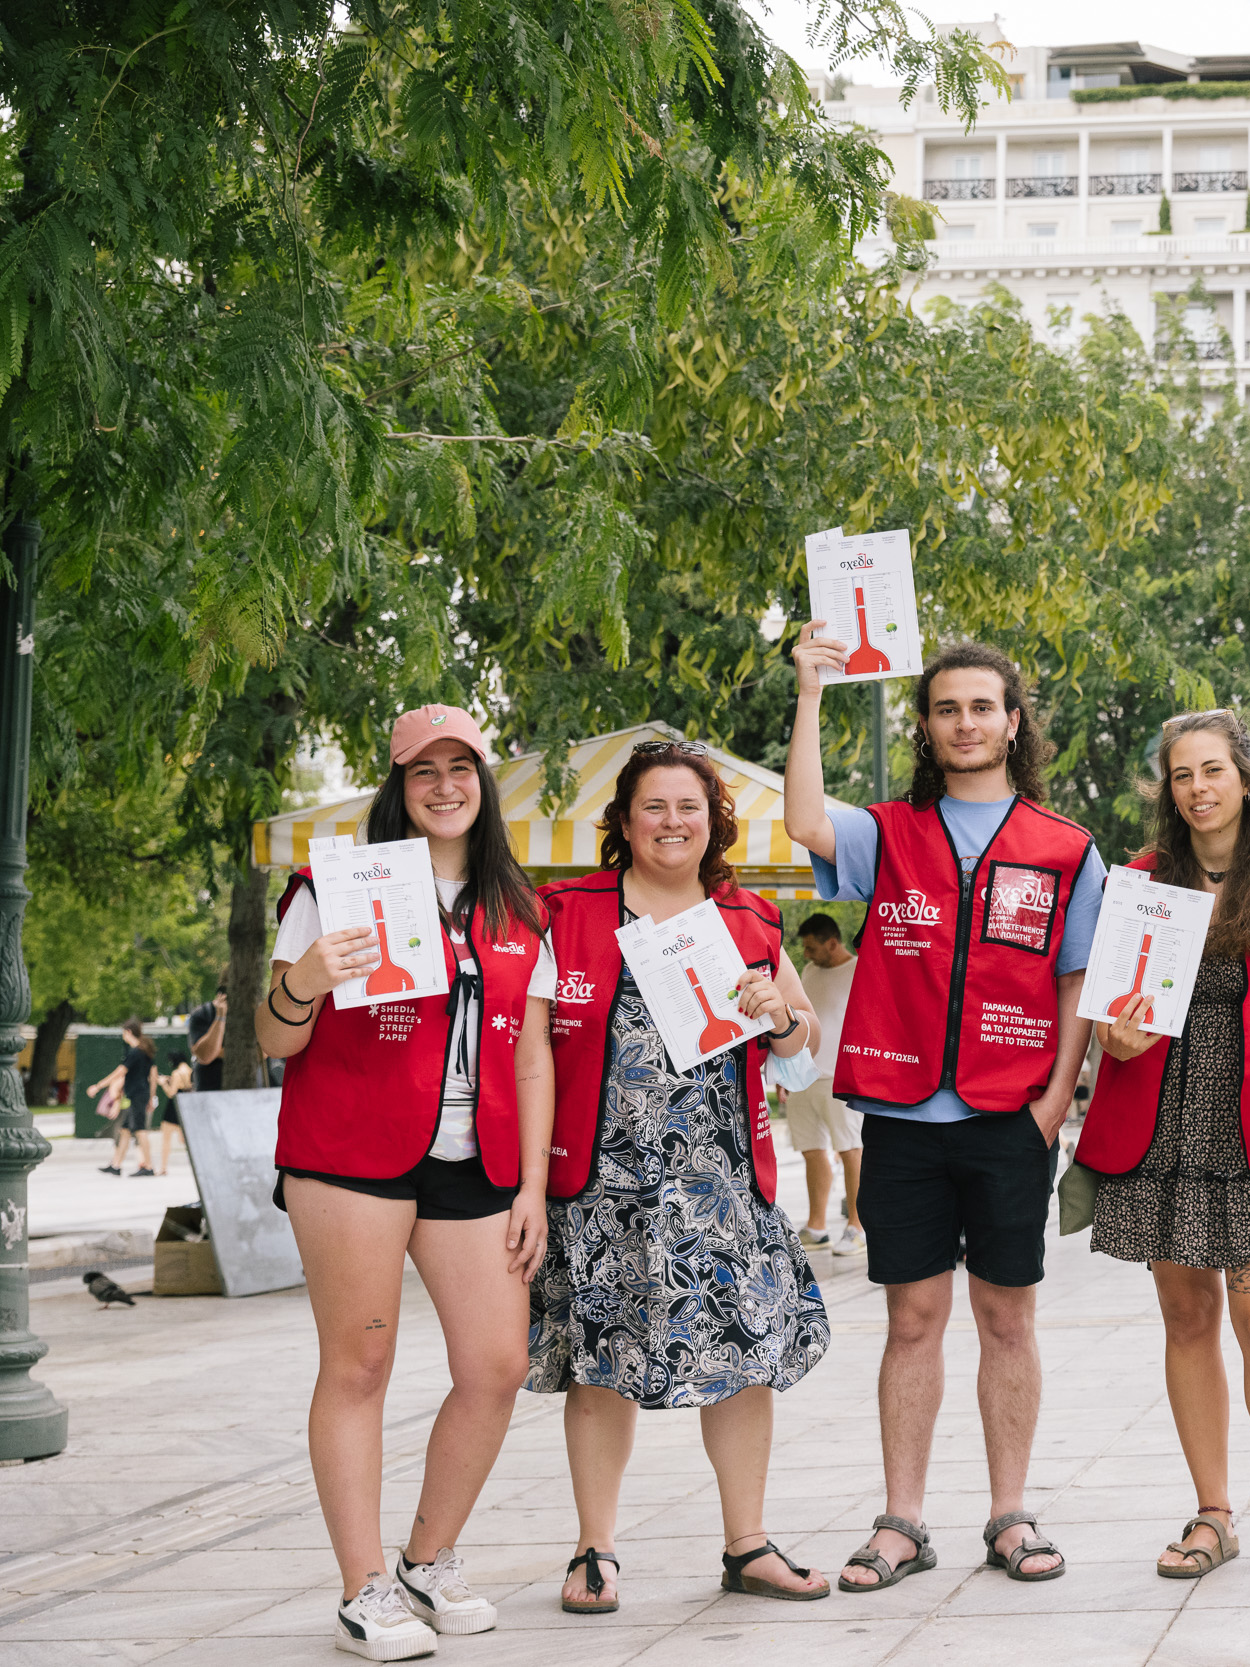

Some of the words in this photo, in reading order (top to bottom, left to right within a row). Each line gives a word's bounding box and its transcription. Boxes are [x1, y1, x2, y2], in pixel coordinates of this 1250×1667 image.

[380, 1005, 416, 1014] SHEDIA
[982, 1002, 1024, 1015] ΠΑΡΑΚΑΛΩ,
[380, 1014, 422, 1024] GREECE's
[981, 1013, 998, 1022] ΑΠΟ
[999, 1015, 1009, 1023] ΤΗ
[1010, 1016, 1036, 1026] ΣΤΙΓΜΗ
[1037, 1020, 1053, 1028] ΠΟΥ
[379, 1023, 413, 1032] STREET
[981, 1023, 992, 1032] ΘΑ
[993, 1025, 1003, 1033] ΤΟ
[1003, 1026, 1048, 1039] ΑΓΟΡΑΣΕΤΕ,
[379, 1033, 408, 1042] PAPER
[980, 1034, 1004, 1044] ΠΑΡΤΕ
[1005, 1036, 1015, 1045] ΤΟ
[1016, 1038, 1045, 1048] ΤΕΥΧΟΣ
[863, 1047, 881, 1058] ΣΤΗ
[883, 1051, 920, 1065] ΦΤΩΧΕΙΑ
[551, 1147, 568, 1157] ΧΕΙΑ
